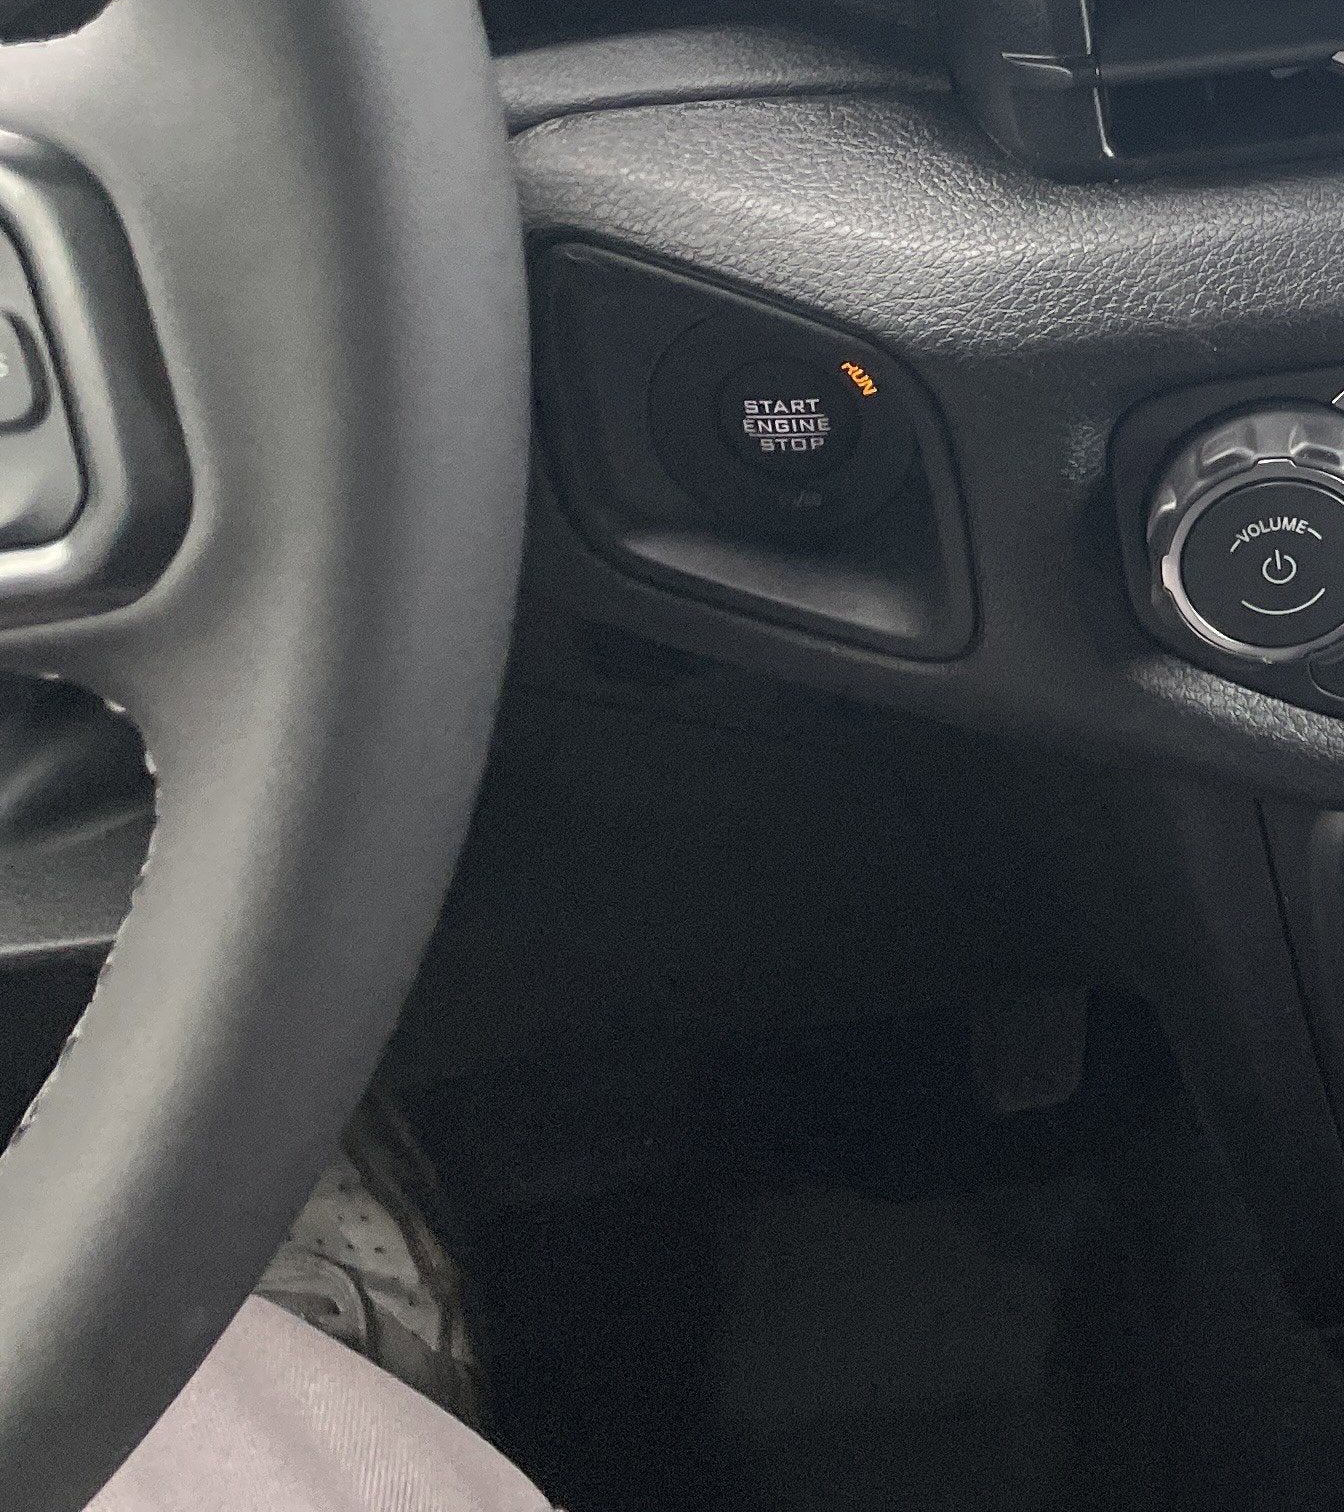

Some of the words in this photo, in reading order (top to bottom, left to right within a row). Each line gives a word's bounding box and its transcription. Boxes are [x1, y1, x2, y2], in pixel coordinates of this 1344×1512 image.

[743, 398, 820, 414] START
[743, 417, 831, 433] ENGINE
[760, 438, 825, 452] STOP
[1236, 517, 1309, 546] VOLUME
